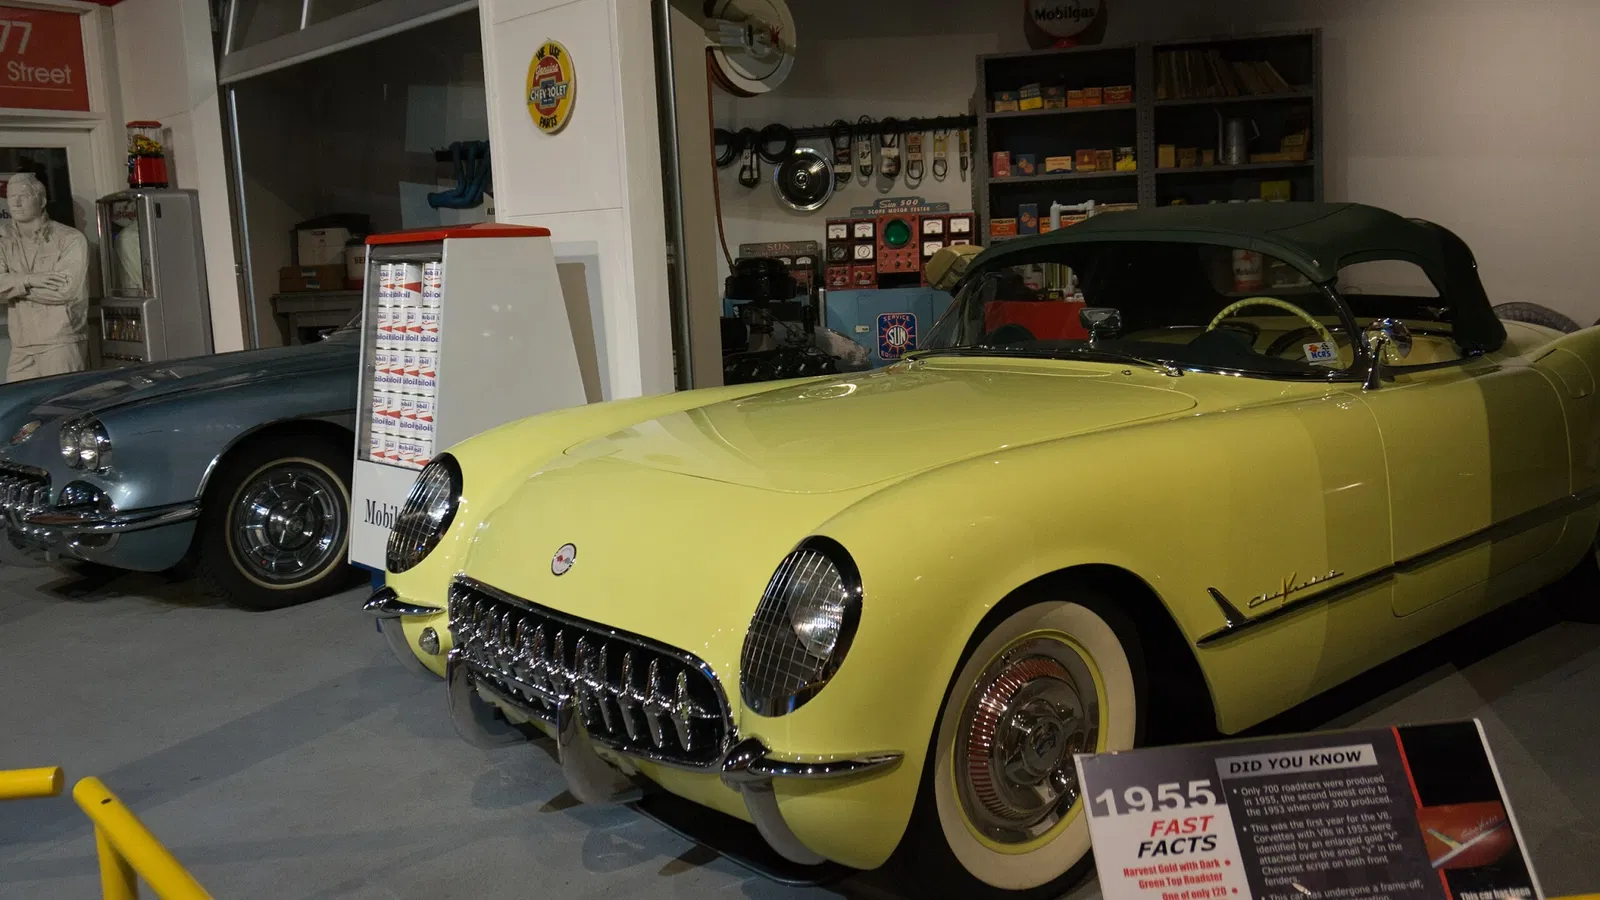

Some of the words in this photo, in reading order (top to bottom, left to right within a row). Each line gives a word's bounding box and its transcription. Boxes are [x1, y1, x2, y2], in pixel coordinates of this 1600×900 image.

[1035, 6, 1094, 22] Mobilgas
[0, 20, 32, 54] 77
[536, 46, 546, 61] WE
[549, 44, 562, 59] USE
[7, 60, 72, 84] Street
[539, 115, 557, 128] PARTS
[879, 199, 897, 209] Sun
[767, 243, 790, 251] SUN
[888, 327, 906, 346] SUN
[1311, 351, 1331, 359] NCRS
[364, 498, 398, 530] Mobil
[1229, 759, 1262, 774] DID
[1268, 756, 1303, 770] YOU
[1310, 751, 1362, 766] KNOW
[1241, 786, 1261, 796] Only
[1264, 784, 1280, 794] 700
[1282, 781, 1321, 792] roadsters
[1324, 779, 1344, 788] were
[1346, 774, 1385, 788] produced
[1096, 779, 1217, 816] 1955
[1244, 798, 1252, 806] in
[1255, 796, 1279, 806] 1955,
[1280, 794, 1296, 803] the
[1298, 791, 1327, 801] second
[1328, 788, 1356, 798] lowest
[1358, 785, 1376, 796] only
[1378, 784, 1388, 793] to
[1246, 808, 1261, 817] the
[1264, 805, 1286, 815] 1953
[1288, 802, 1310, 812] when
[1312, 800, 1330, 811] only
[1332, 799, 1349, 808] 300
[1350, 795, 1392, 808] produced.
[1150, 816, 1214, 838] FAST
[1250, 824, 1269, 832] This
[1270, 823, 1288, 832] was
[1290, 820, 1304, 829] the
[1306, 818, 1324, 828] first
[1326, 817, 1344, 827] year
[1254, 833, 1295, 844] Corvettes
[1296, 830, 1316, 839] with
[1347, 824, 1368, 834] 1955
[1370, 822, 1392, 831] were
[1137, 835, 1218, 858] FACTS
[1256, 842, 1296, 854] identified
[1298, 842, 1308, 850] by
[1325, 835, 1362, 847] enlarged
[1364, 834, 1382, 845] gold
[1260, 853, 1297, 865] attached
[1299, 852, 1318, 860] over
[1320, 849, 1336, 858] the
[1337, 846, 1360, 856] small
[1388, 842, 1402, 852] the
[1123, 866, 1157, 877] Harvest
[1158, 864, 1178, 874] Gold
[1180, 861, 1198, 872] with
[1200, 858, 1220, 869] Dark
[1262, 864, 1304, 876] Chevrolet
[1306, 860, 1330, 872] script
[1332, 860, 1344, 868] on
[1345, 857, 1366, 867] both
[1367, 854, 1388, 865] front
[1138, 878, 1165, 889] Green
[1166, 876, 1182, 886] Top
[1184, 872, 1222, 885] Roadster
[1264, 876, 1300, 886] fenders.
[1306, 889, 1322, 898] has
[1324, 886, 1370, 898] undergone
[1373, 884, 1379, 892] a
[1380, 879, 1424, 892] frame-off,
[1162, 892, 1179, 900] One
[1180, 890, 1190, 900] of
[1192, 888, 1210, 900] only
[1212, 886, 1226, 896] 120
[1460, 892, 1479, 900] This
[1479, 891, 1493, 900] car
[1494, 888, 1508, 900] has
[1509, 886, 1531, 897] been
